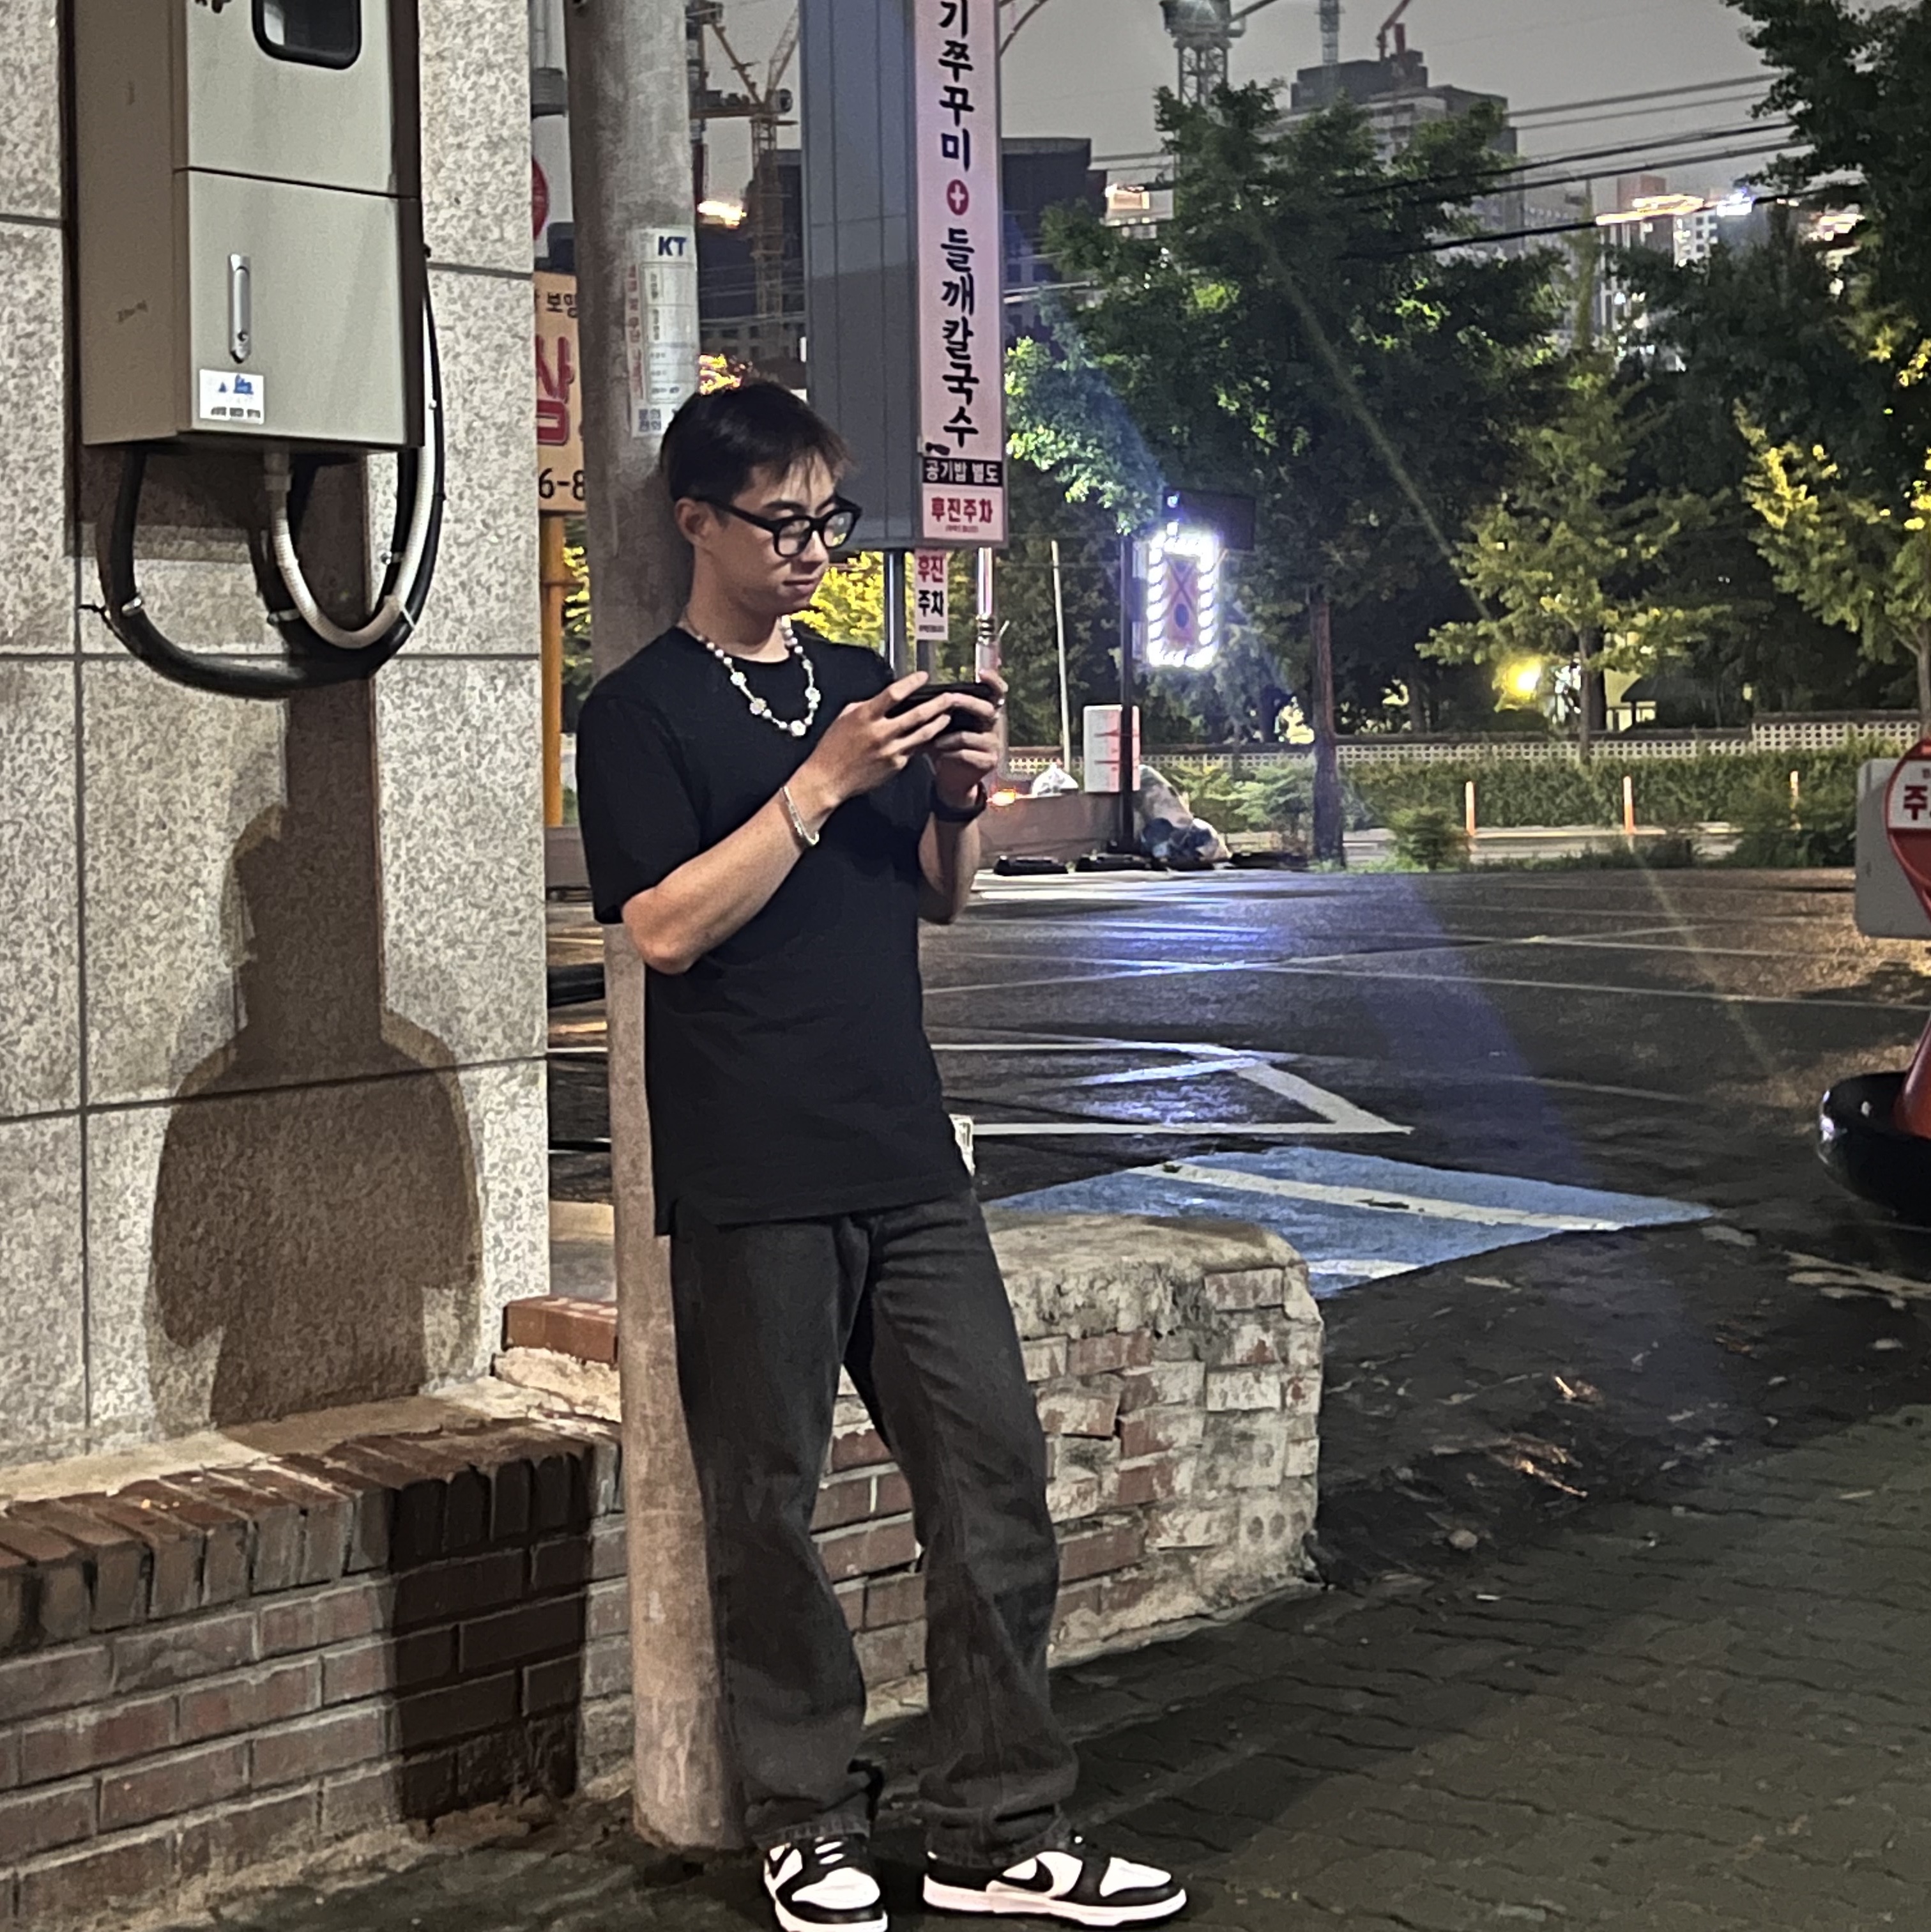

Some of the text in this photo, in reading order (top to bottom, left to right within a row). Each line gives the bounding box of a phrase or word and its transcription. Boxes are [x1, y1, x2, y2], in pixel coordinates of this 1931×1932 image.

[658, 236, 687, 256] KT
[940, 227, 981, 448] 들깨칼국수
[926, 460, 999, 483] 공기밥 별도
[931, 496, 993, 523] 후진주차
[918, 555, 944, 583] 후진
[918, 589, 944, 617] 주차
[1904, 785, 1931, 820] 주
